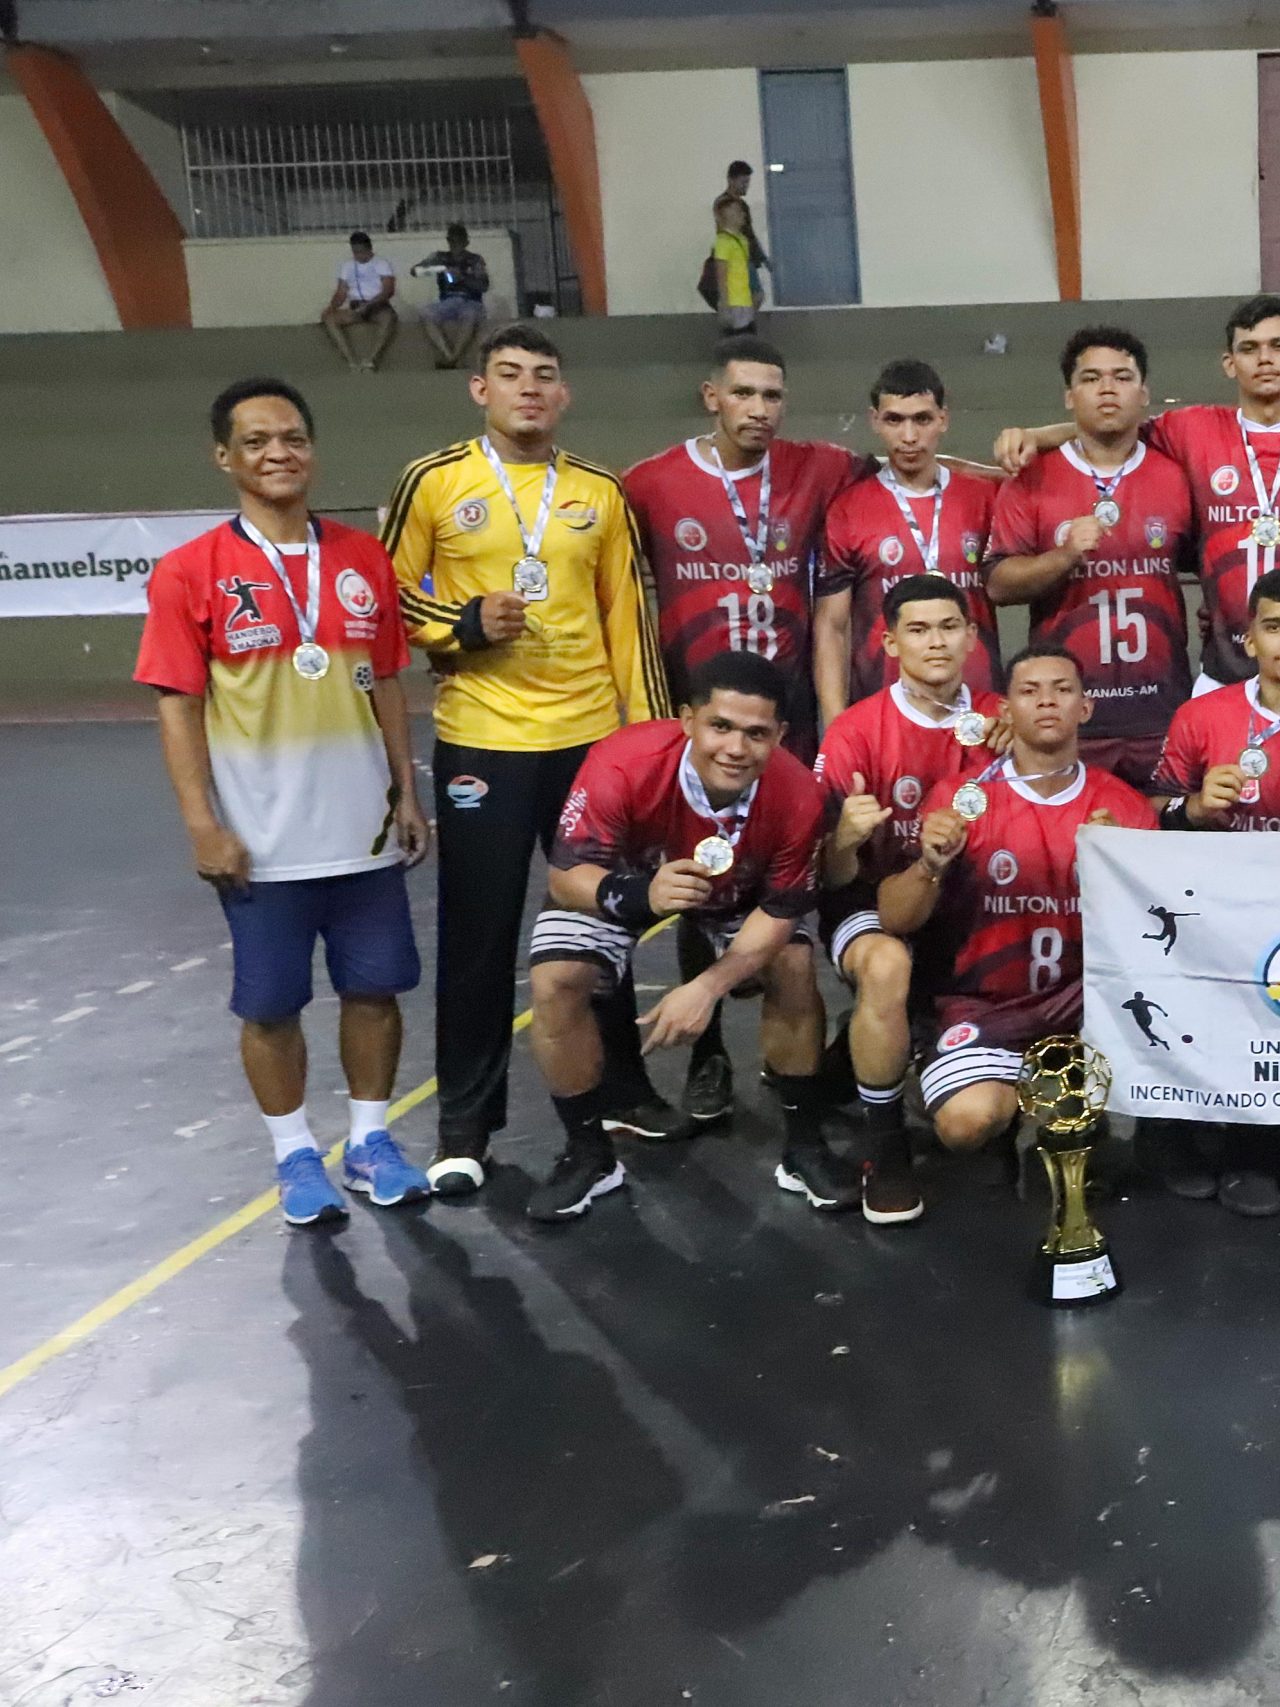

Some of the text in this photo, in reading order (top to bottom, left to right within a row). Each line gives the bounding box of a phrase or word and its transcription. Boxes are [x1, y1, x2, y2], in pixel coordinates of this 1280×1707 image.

[1133, 557, 1171, 575] LINS
[717, 592, 778, 661] 18
[1088, 587, 1148, 665] 15
[984, 895, 1058, 915] NILTON
[1029, 927, 1063, 994] 8
[1130, 1084, 1268, 1109] INCENTIVANDO
